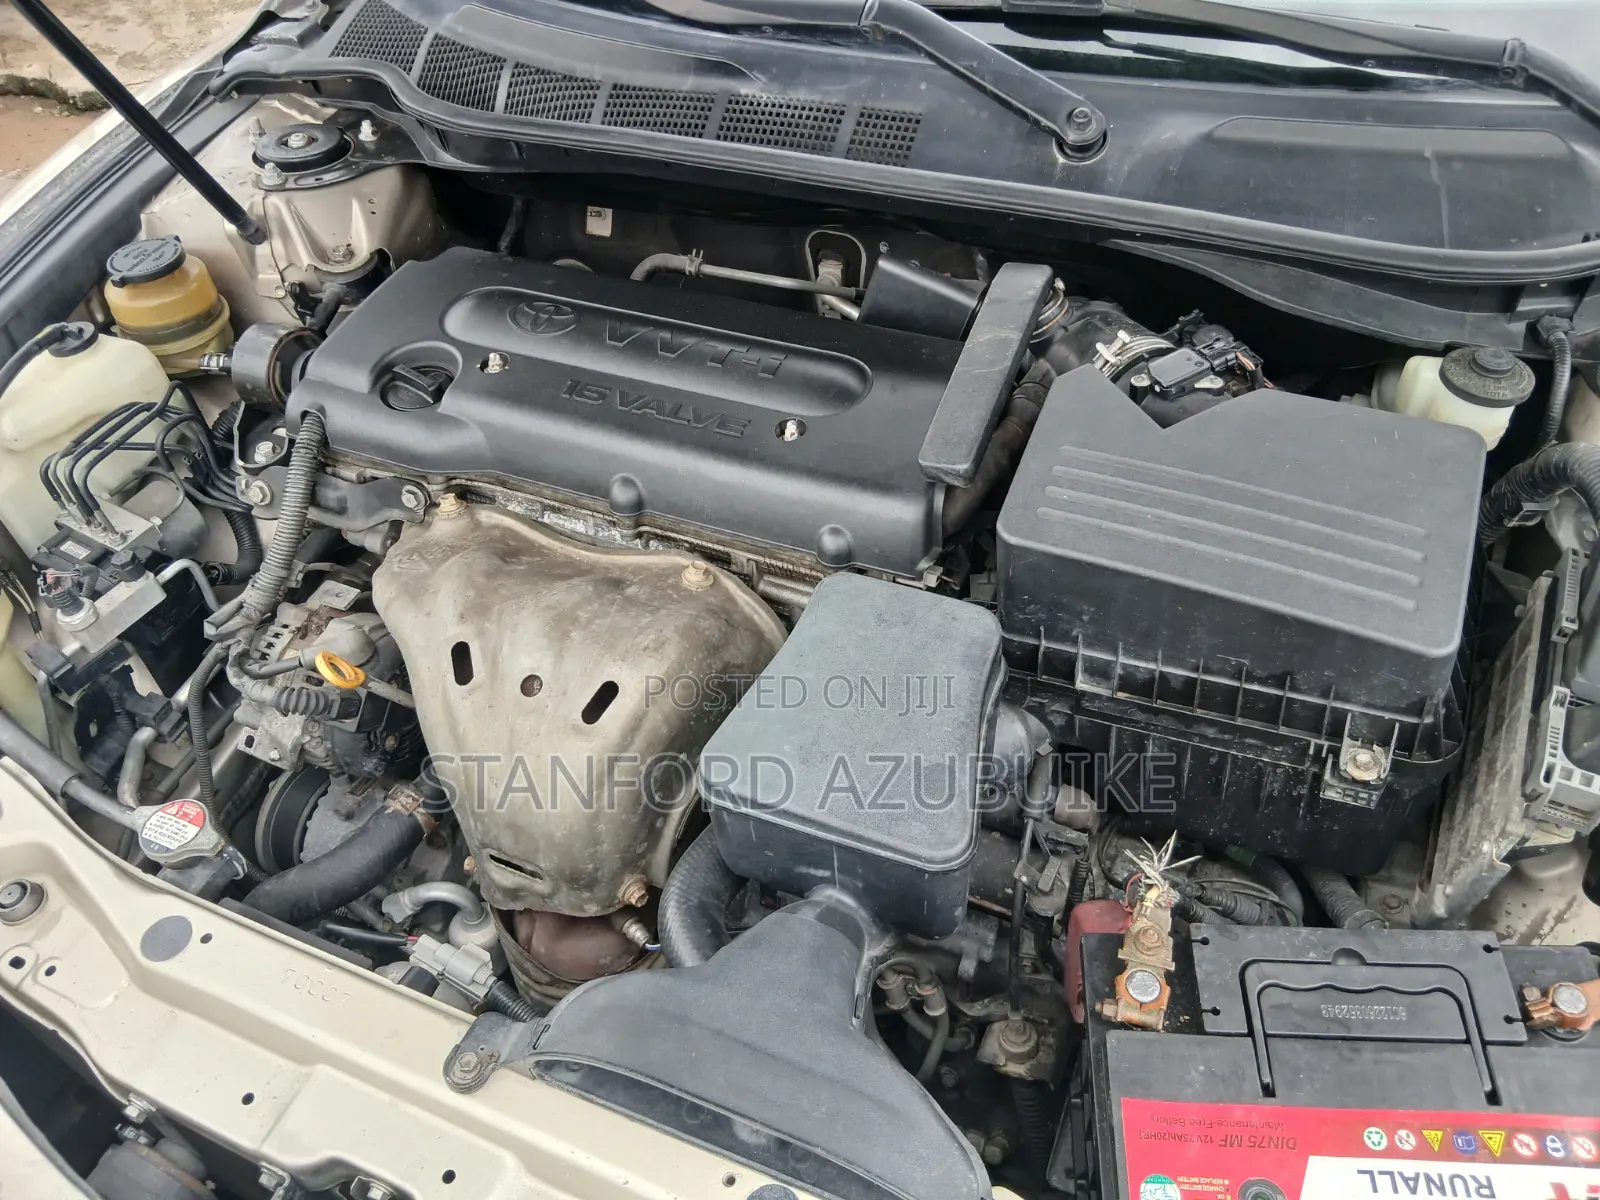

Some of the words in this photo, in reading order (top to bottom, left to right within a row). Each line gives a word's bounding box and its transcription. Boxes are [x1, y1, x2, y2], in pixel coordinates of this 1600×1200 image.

[561, 379, 611, 404] 16
[617, 390, 752, 437] VALVE
[1150, 1114, 1186, 1127] Battery
[1189, 1118, 1284, 1131] Maintenance-Free
[1217, 1133, 1243, 1148] MF
[1247, 1134, 1297, 1150] DIN75
[1356, 1169, 1496, 1199] RUNALL
